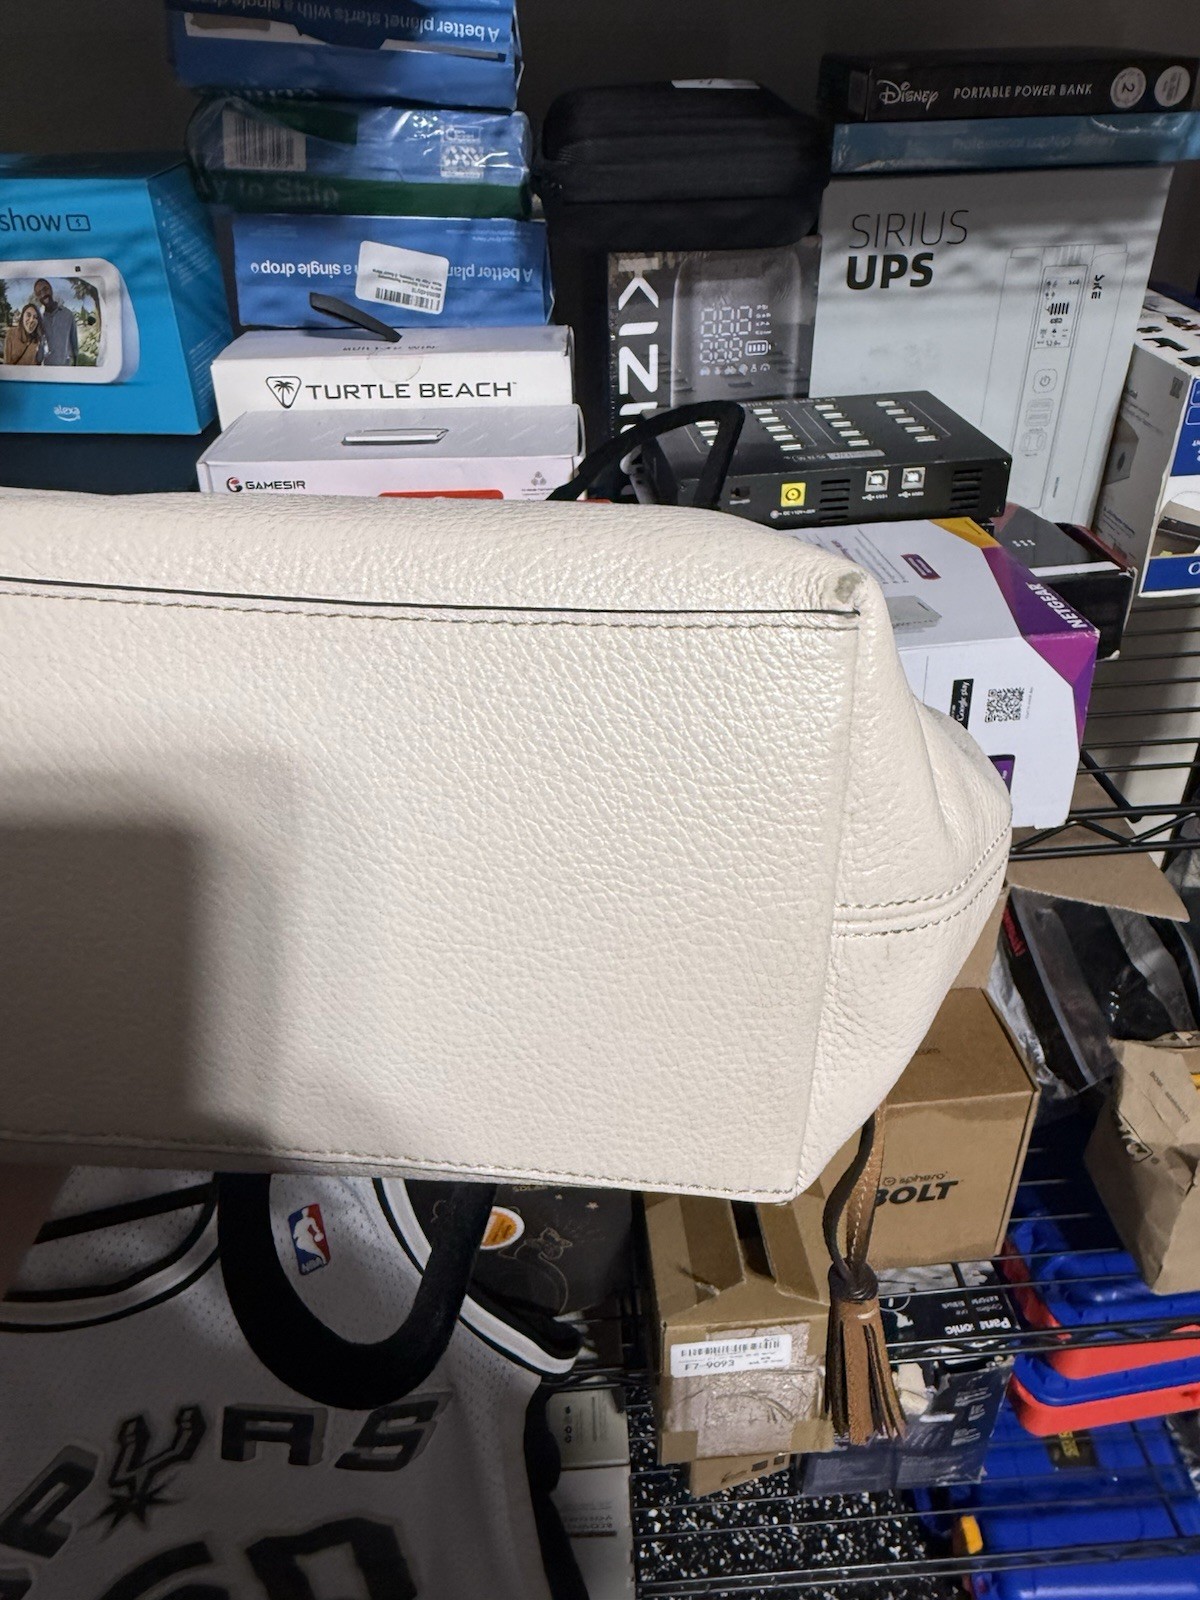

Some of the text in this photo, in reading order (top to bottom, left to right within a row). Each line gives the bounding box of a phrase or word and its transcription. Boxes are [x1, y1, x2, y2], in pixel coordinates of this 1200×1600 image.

[437, 20, 486, 40] better
[488, 26, 500, 43] A
[953, 85, 1012, 100] PORTABLE
[1014, 84, 1057, 98] POWER
[1059, 83, 1093, 96] BANK
[0, 207, 61, 232] show
[849, 210, 969, 250] SIRIUS
[260, 259, 296, 277] drop
[298, 260, 341, 279] single
[478, 266, 521, 281] better
[521, 267, 534, 281] A
[846, 252, 934, 290] UPS
[305, 381, 513, 400] TURTLE BEACH
[245, 480, 306, 490] GAMESIR
[1026, 582, 1088, 629] NETGEAR
